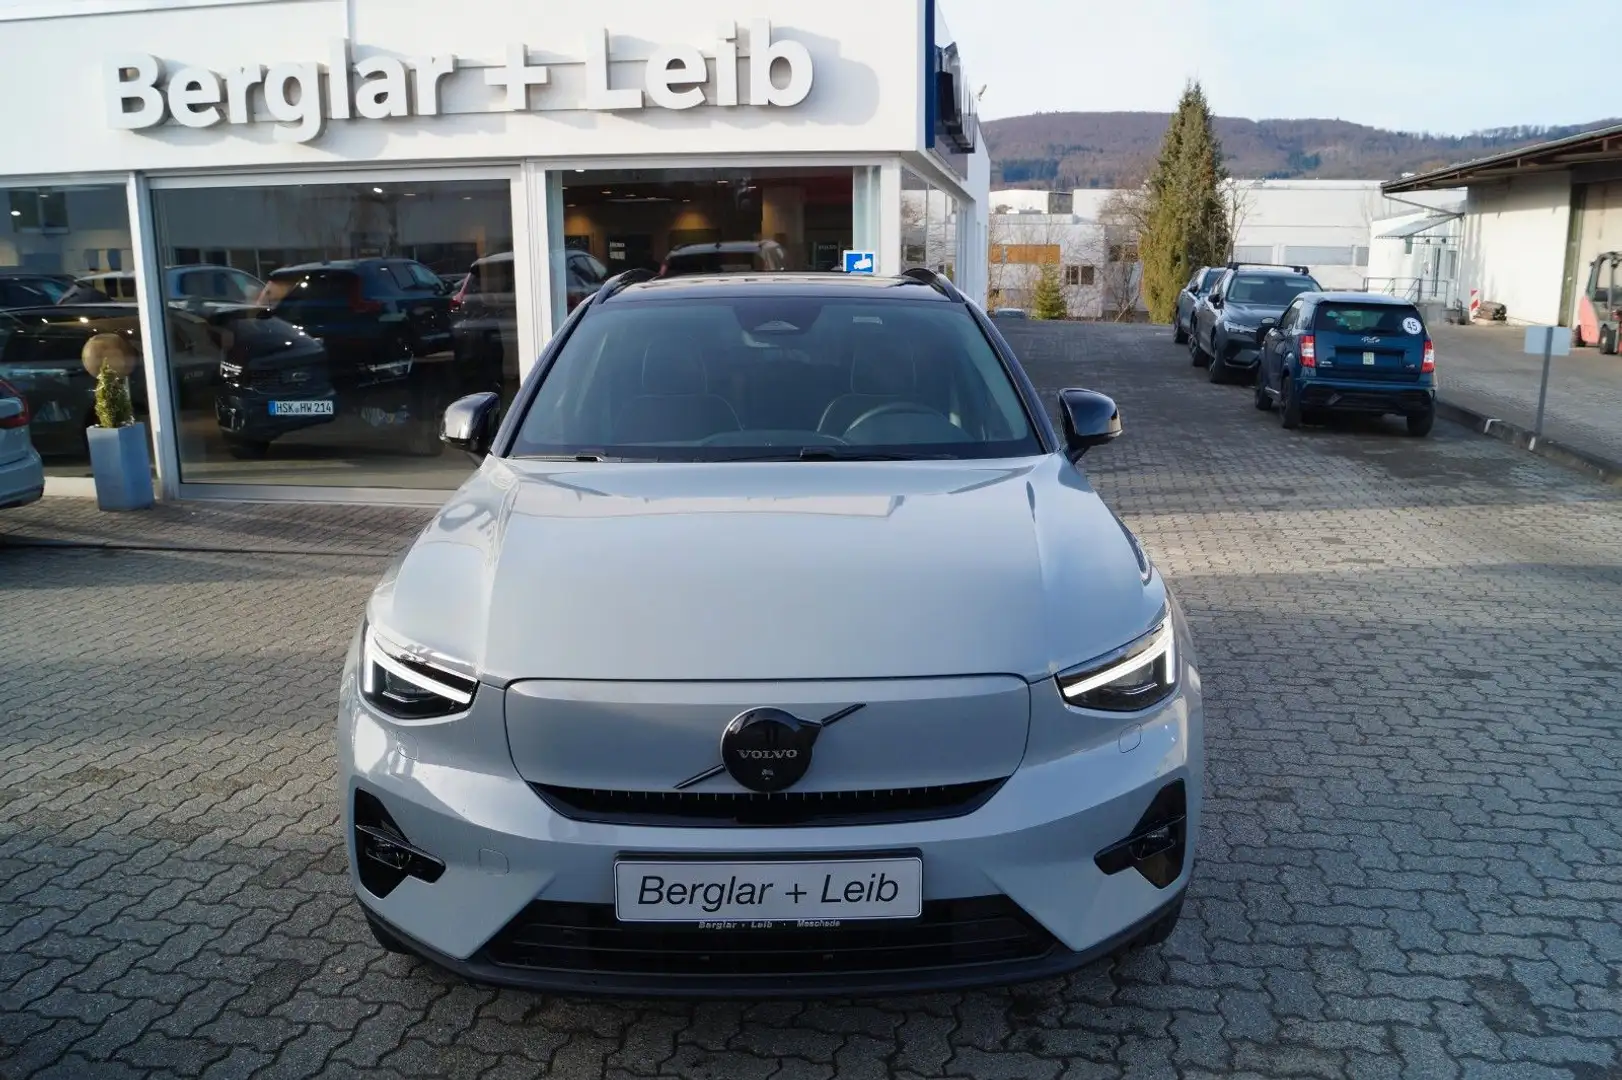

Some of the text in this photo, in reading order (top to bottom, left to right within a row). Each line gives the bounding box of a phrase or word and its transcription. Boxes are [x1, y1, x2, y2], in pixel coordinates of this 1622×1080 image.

[104, 15, 814, 143] Berglar + Leib
[1406, 321, 1418, 332] 45
[276, 402, 332, 413] HSK HW 214
[736, 749, 798, 759] VOLVO
[637, 872, 899, 912] Berglar + Leib
[698, 920, 738, 930] Berglar
[750, 920, 773, 929] Leib
